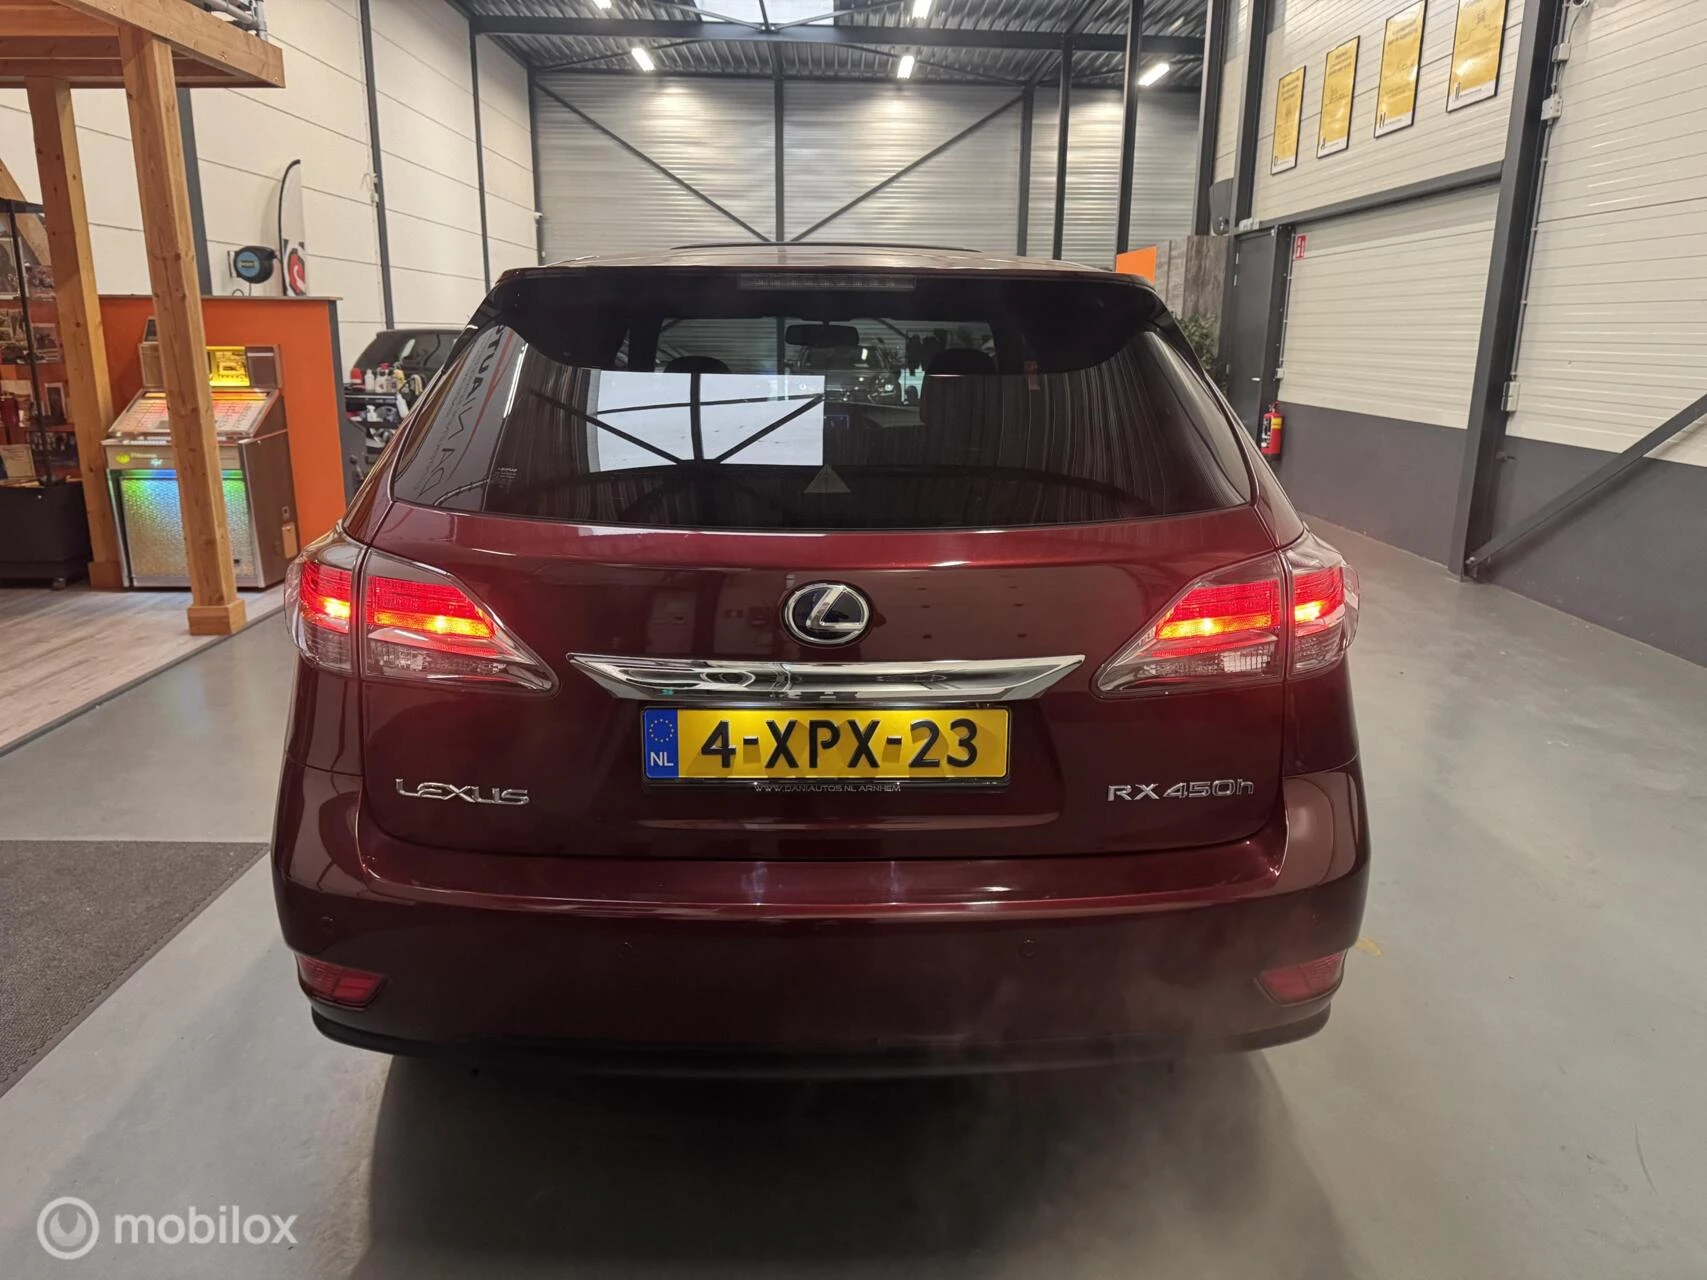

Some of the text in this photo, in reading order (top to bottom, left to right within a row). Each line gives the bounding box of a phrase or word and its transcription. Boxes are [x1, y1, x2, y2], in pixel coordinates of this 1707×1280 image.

[700, 717, 979, 769] 4-XPX-23
[650, 751, 675, 767] NL
[395, 778, 530, 806] LEXUS
[858, 783, 902, 793] ARNHEM
[1107, 778, 1255, 802] RX 450h
